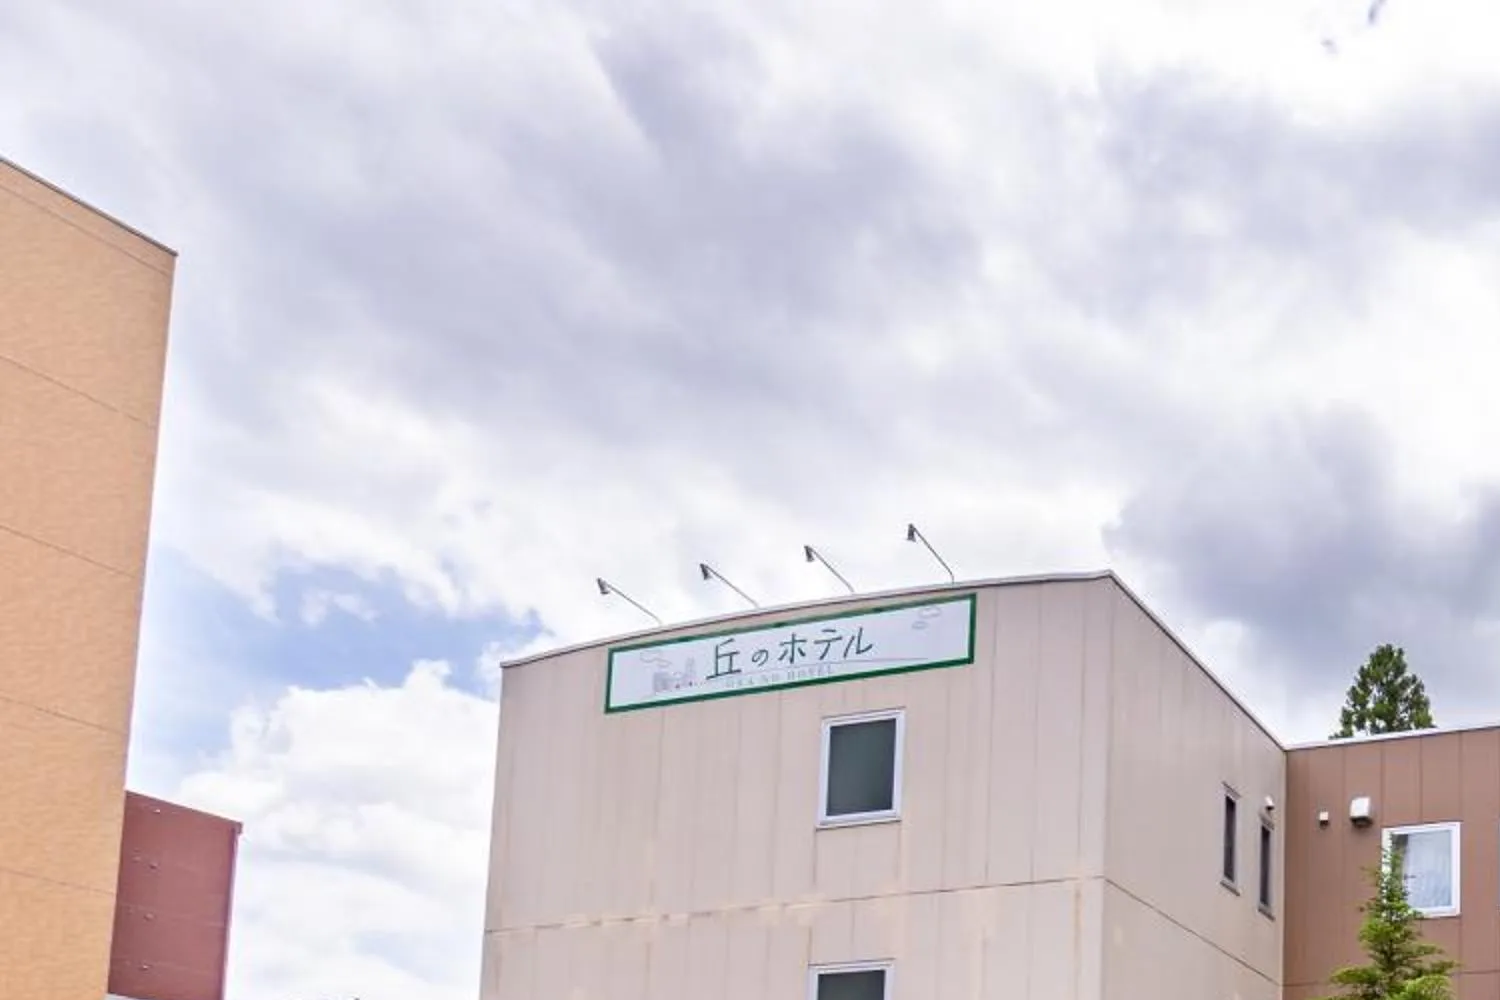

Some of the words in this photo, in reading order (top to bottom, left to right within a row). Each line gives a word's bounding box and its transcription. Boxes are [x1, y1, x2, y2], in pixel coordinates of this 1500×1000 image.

[706, 627, 873, 680] 丘のホテル
